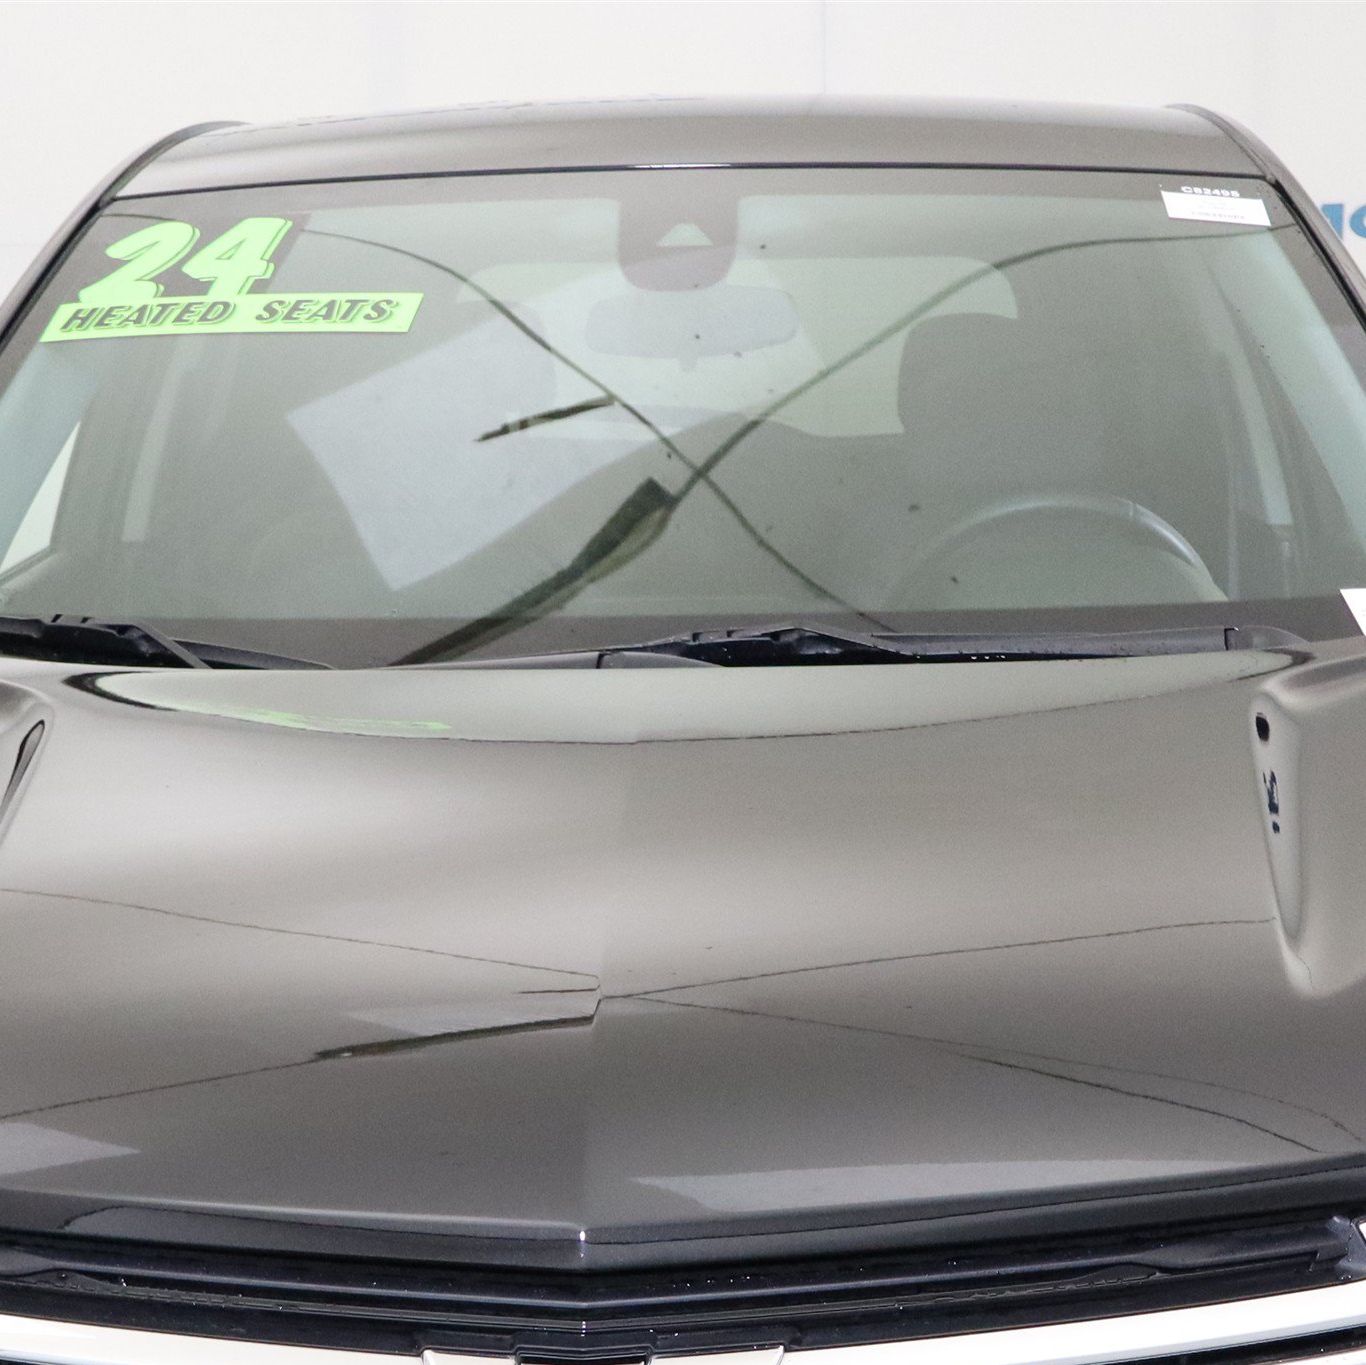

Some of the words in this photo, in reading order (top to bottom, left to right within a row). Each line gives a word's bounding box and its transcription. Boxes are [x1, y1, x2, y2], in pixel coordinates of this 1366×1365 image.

[79, 216, 292, 302] 24
[60, 301, 235, 332] HEATED
[255, 299, 399, 324] SEATS
